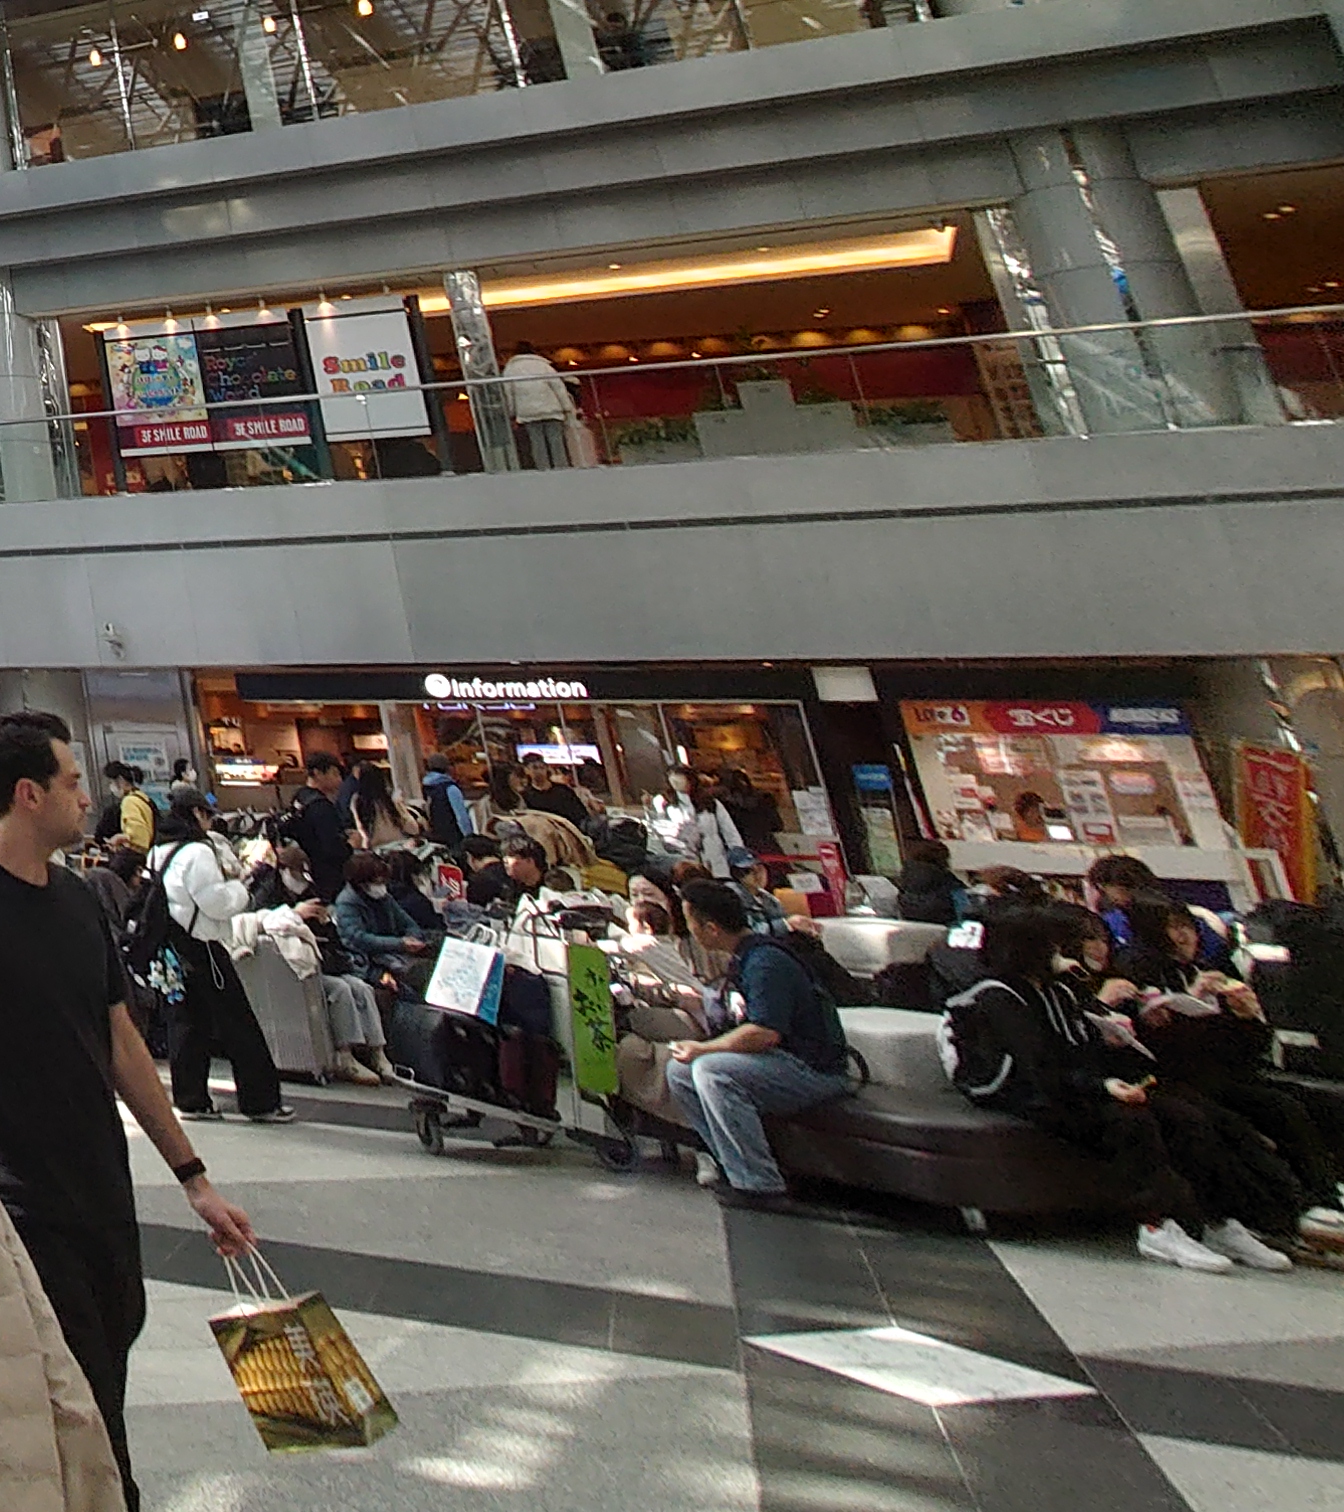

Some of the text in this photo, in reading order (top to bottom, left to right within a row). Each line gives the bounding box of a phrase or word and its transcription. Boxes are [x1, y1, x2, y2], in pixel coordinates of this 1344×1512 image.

[322, 351, 406, 374] Smile
[141, 426, 208, 443] 3F SMILE ROAD
[247, 419, 278, 435] SMILE
[279, 417, 305, 433] ROAD
[451, 677, 589, 698] Information
